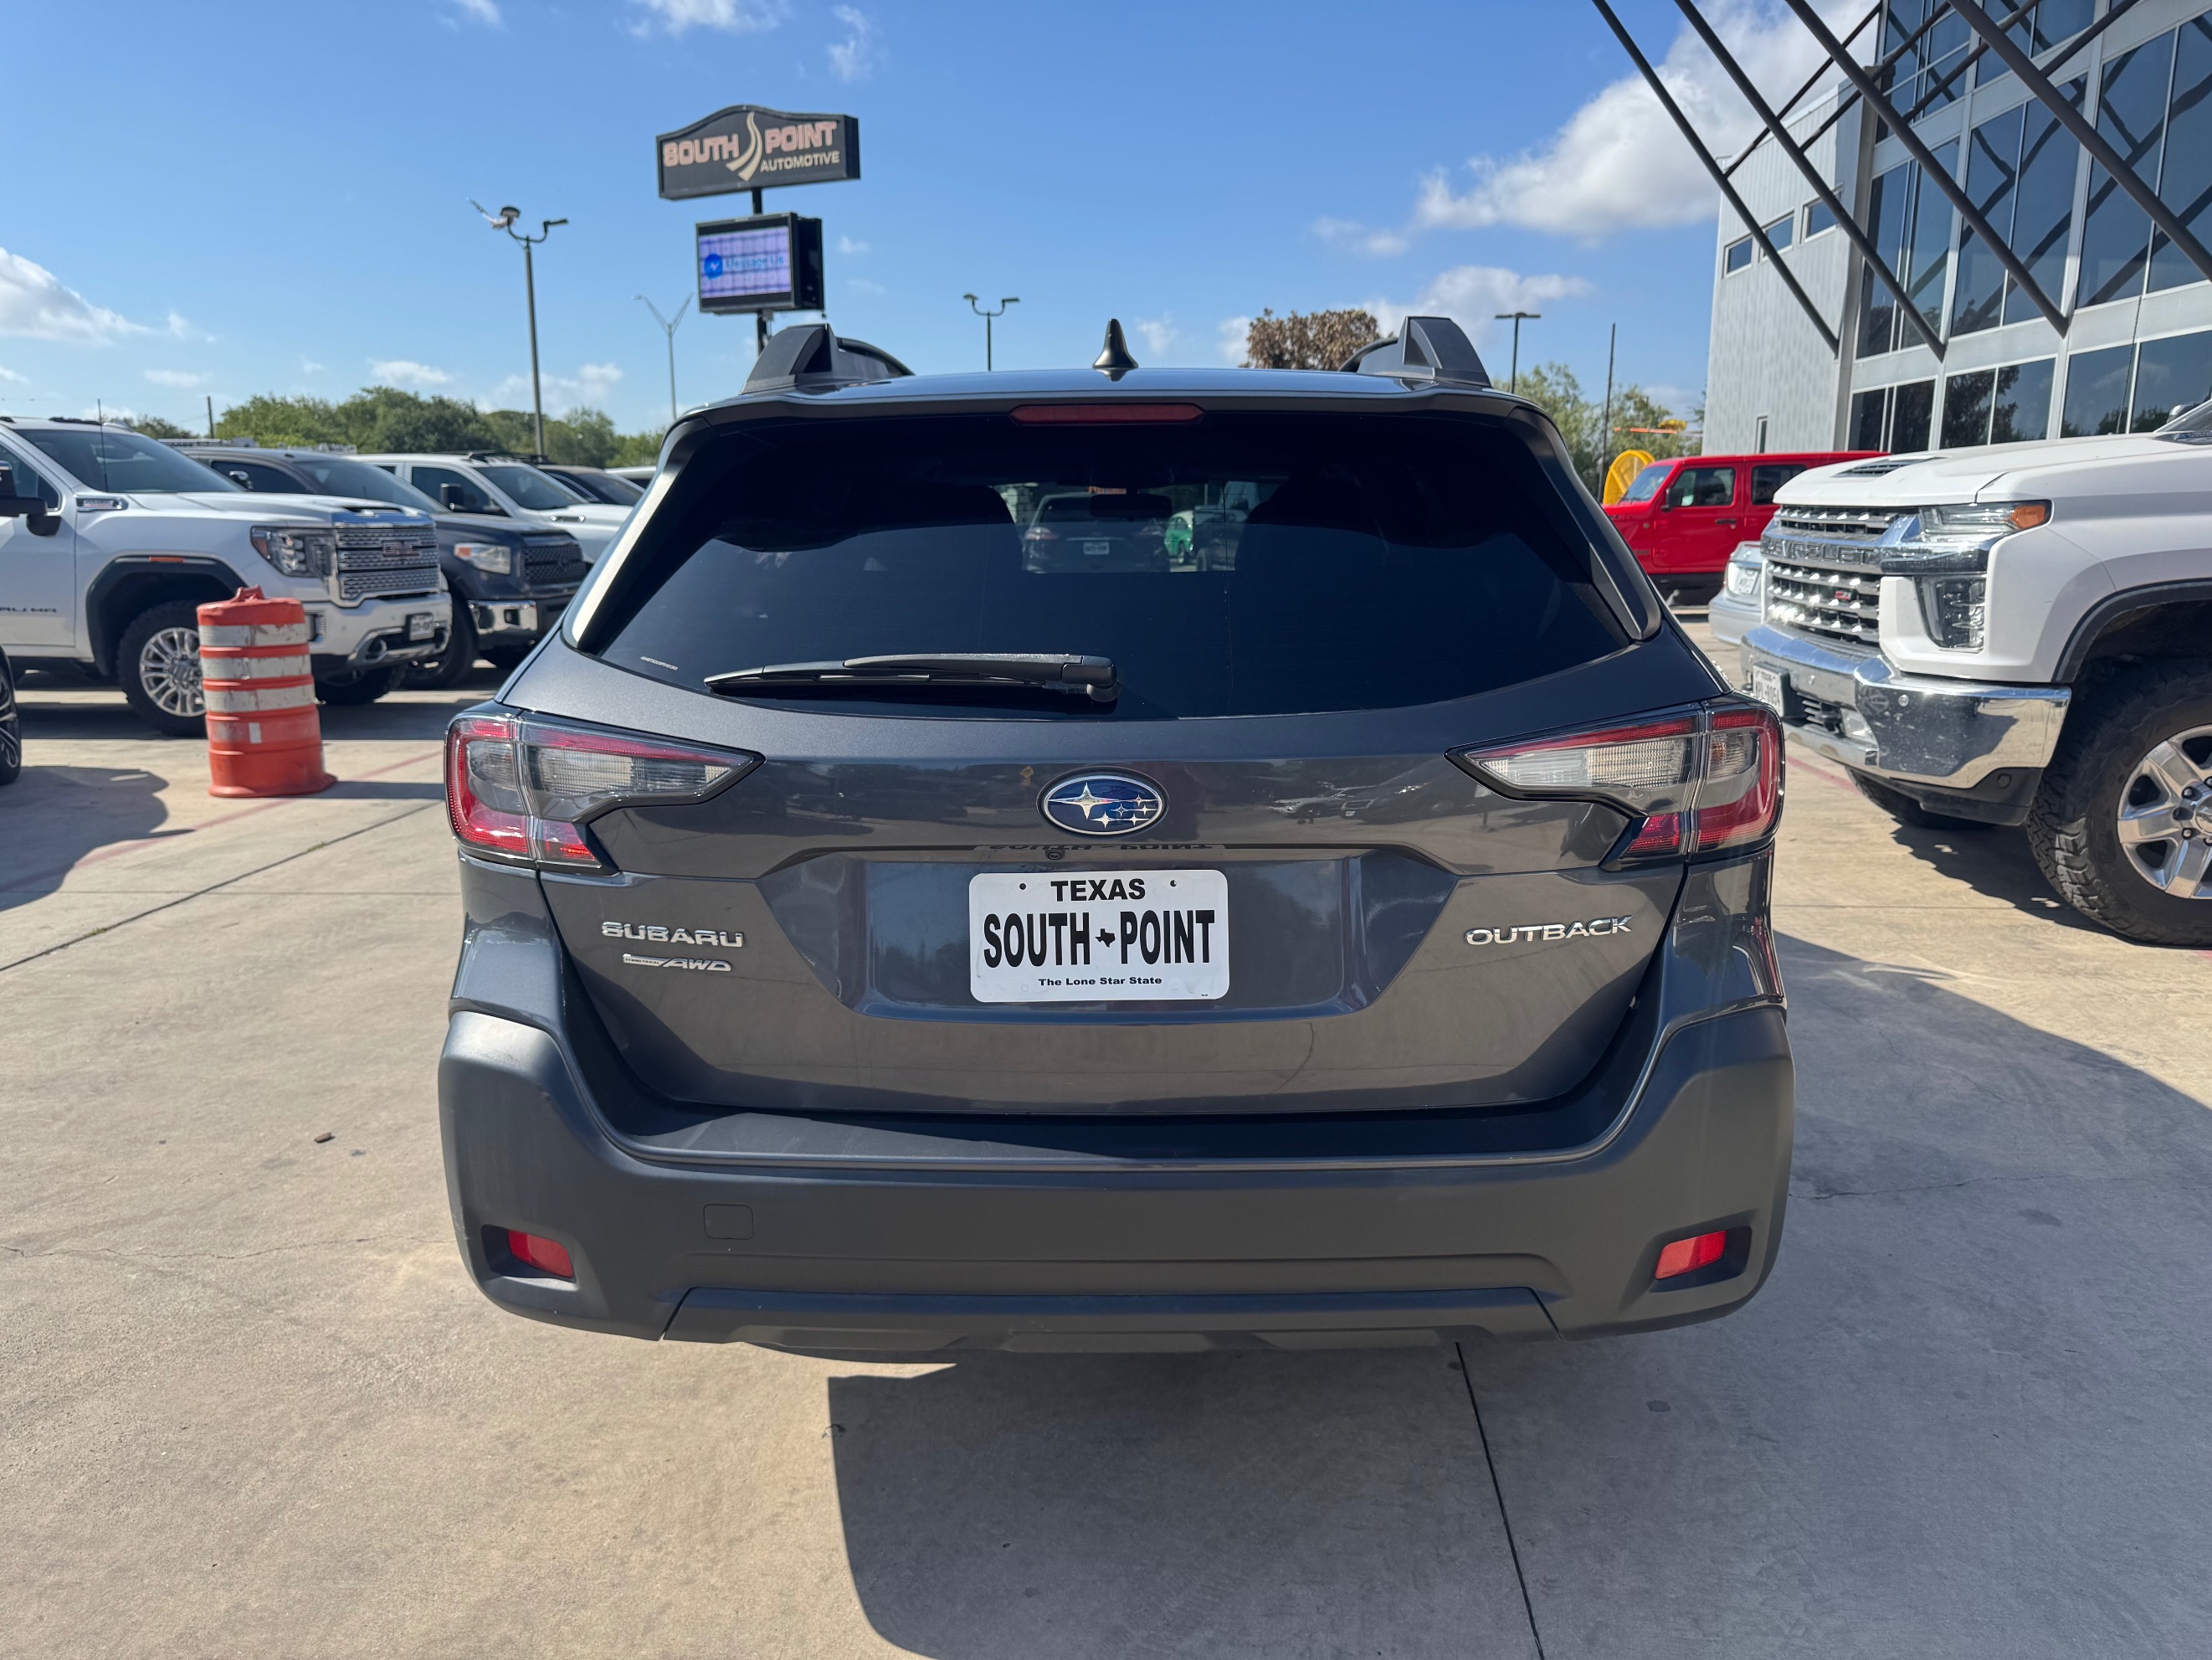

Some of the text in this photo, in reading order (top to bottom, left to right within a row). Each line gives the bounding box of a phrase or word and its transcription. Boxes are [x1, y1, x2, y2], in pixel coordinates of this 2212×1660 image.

[663, 121, 837, 167] SOUTH POINT
[760, 151, 840, 172] AUTOMOTIVE
[1050, 878, 1146, 902] TEXAS
[602, 921, 744, 948] SUBARU
[983, 909, 1215, 969] SOUTH POINT
[1465, 914, 1633, 945] OUTBACK
[663, 957, 732, 971] AWD
[1039, 978, 1061, 986] The
[1100, 977, 1126, 985] Star
[1129, 976, 1162, 984] State
